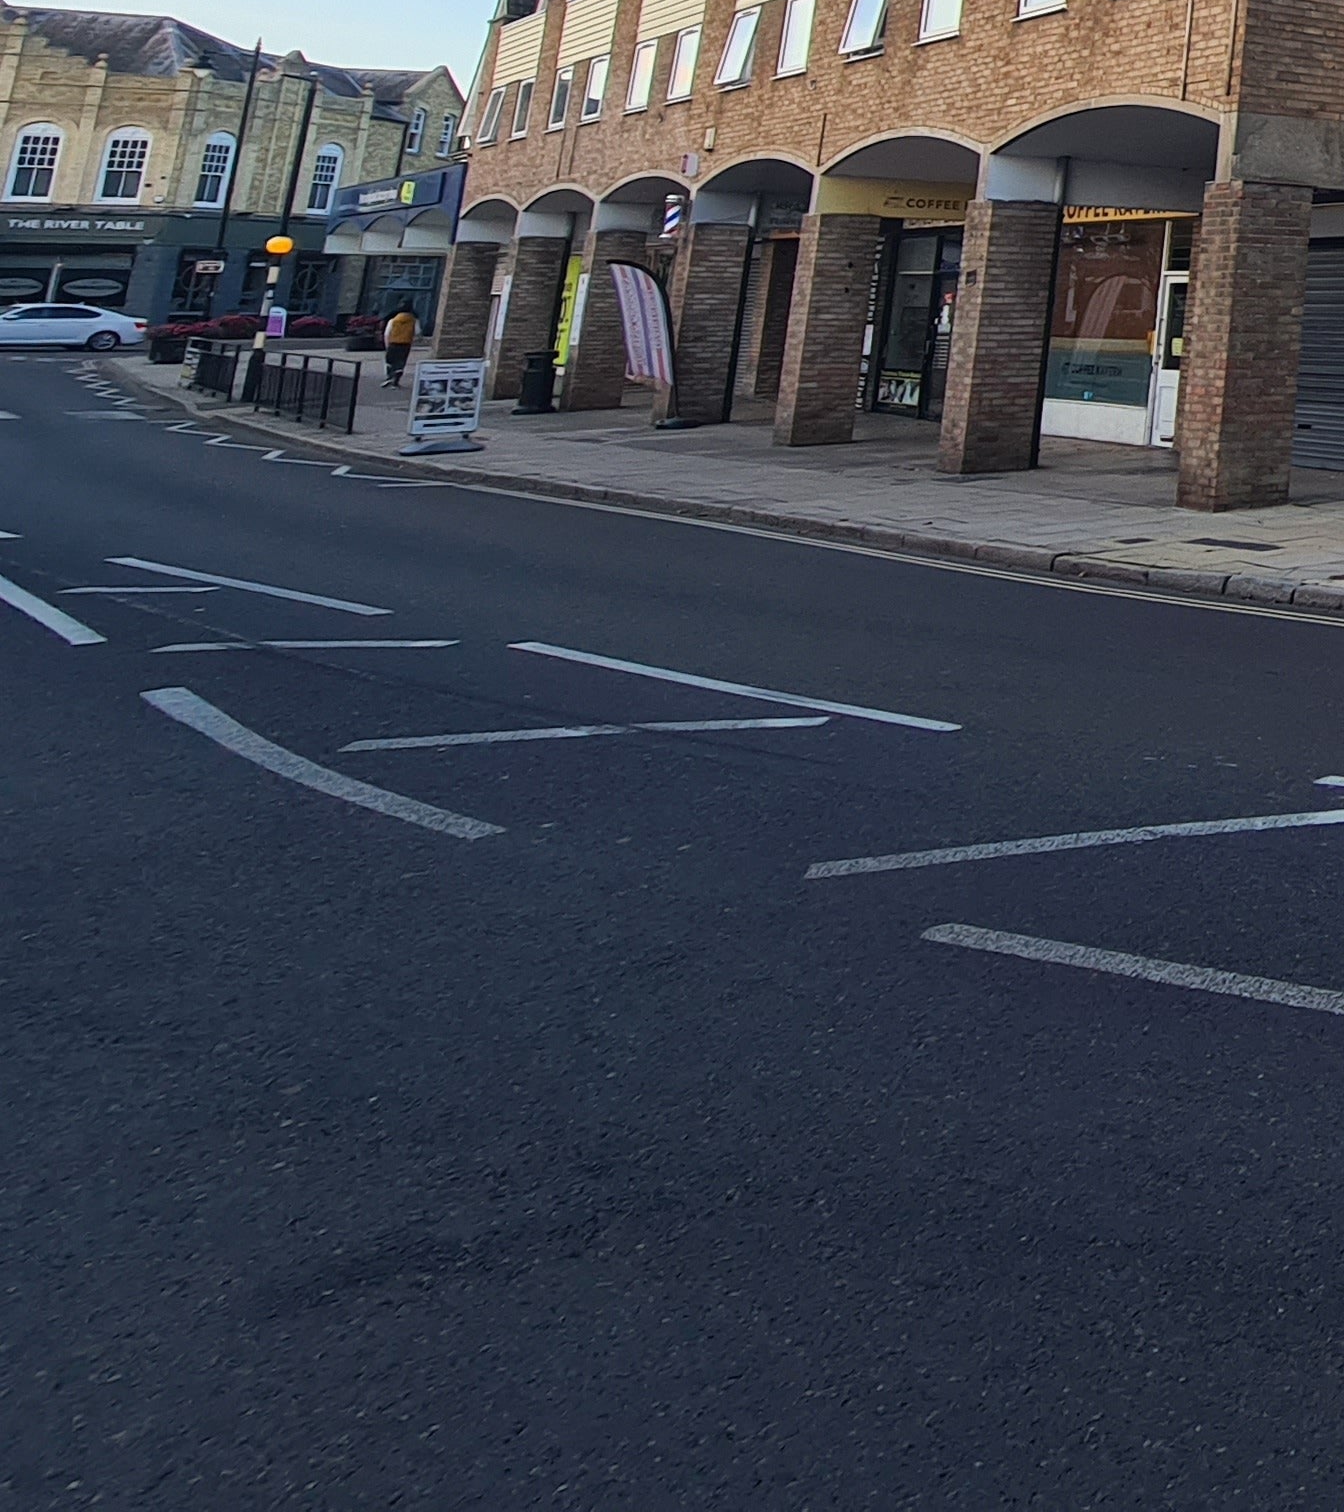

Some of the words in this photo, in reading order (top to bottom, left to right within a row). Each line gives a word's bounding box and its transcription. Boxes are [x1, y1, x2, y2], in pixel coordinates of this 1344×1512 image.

[905, 198, 960, 210] COFFEE
[8, 219, 41, 229] THE
[43, 219, 90, 230] RIVER
[94, 220, 145, 230] TABLE
